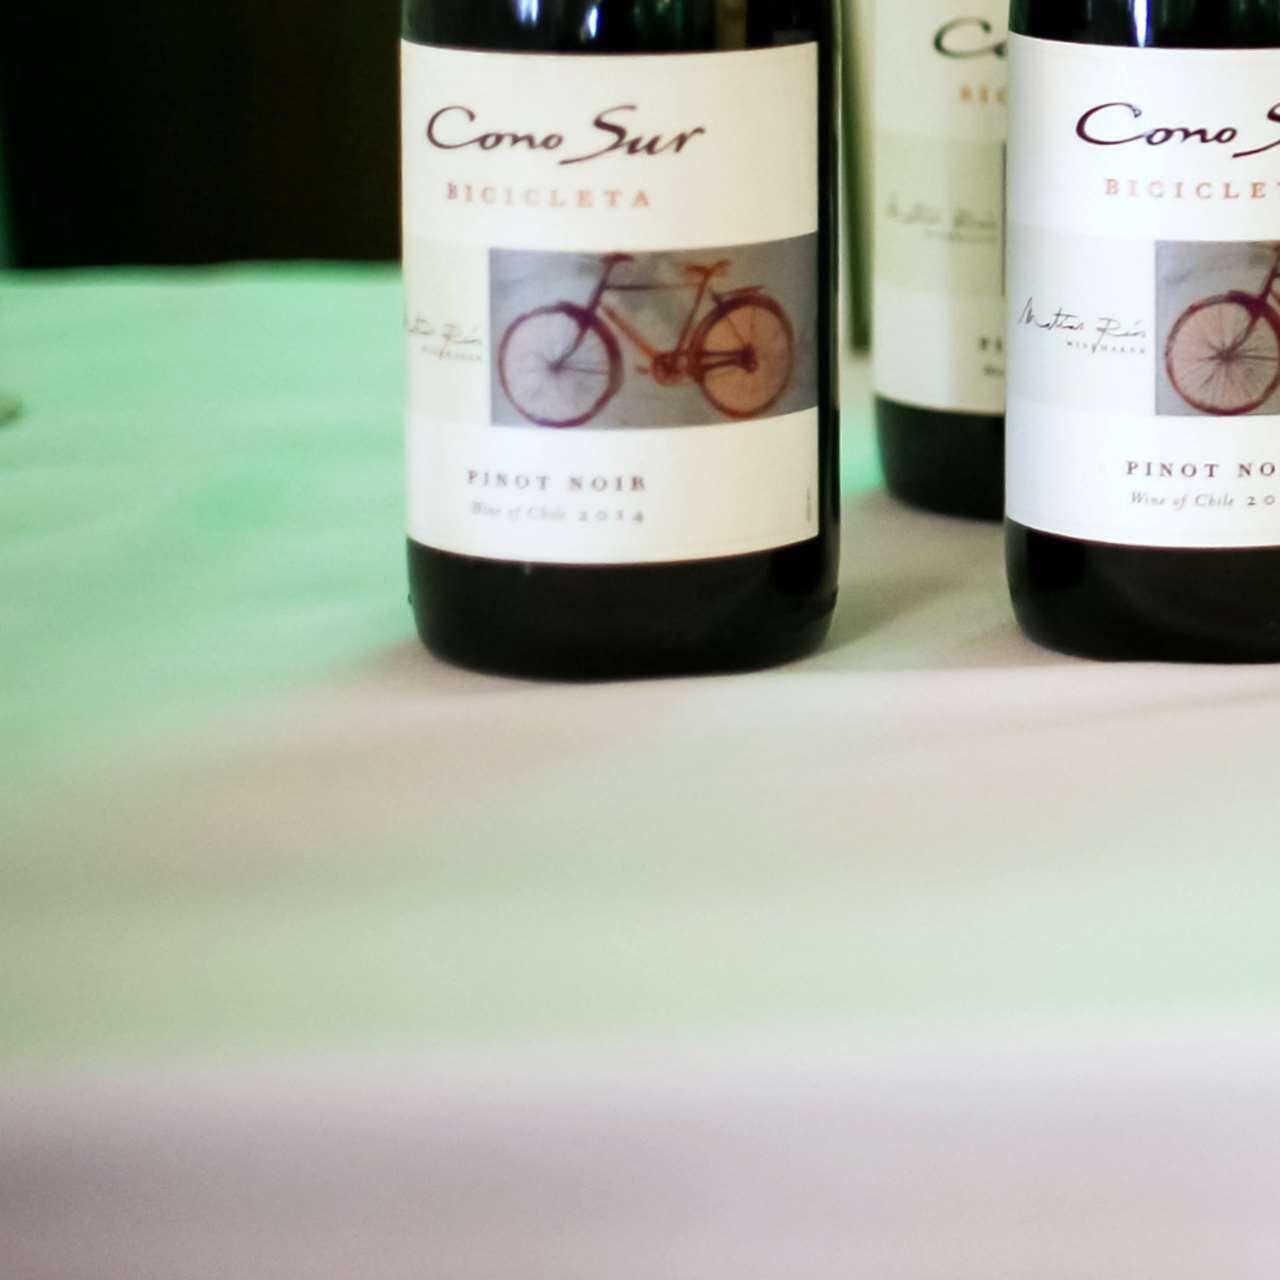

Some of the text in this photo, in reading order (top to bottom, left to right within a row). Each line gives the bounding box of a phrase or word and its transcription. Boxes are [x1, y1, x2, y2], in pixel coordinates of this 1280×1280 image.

[425, 105, 706, 165] Cono Sur
[1075, 101, 1236, 146] Cono
[446, 181, 652, 209] BICICLETA
[467, 469, 646, 492] PINOT NOIR
[1127, 460, 1219, 478] PINOT
